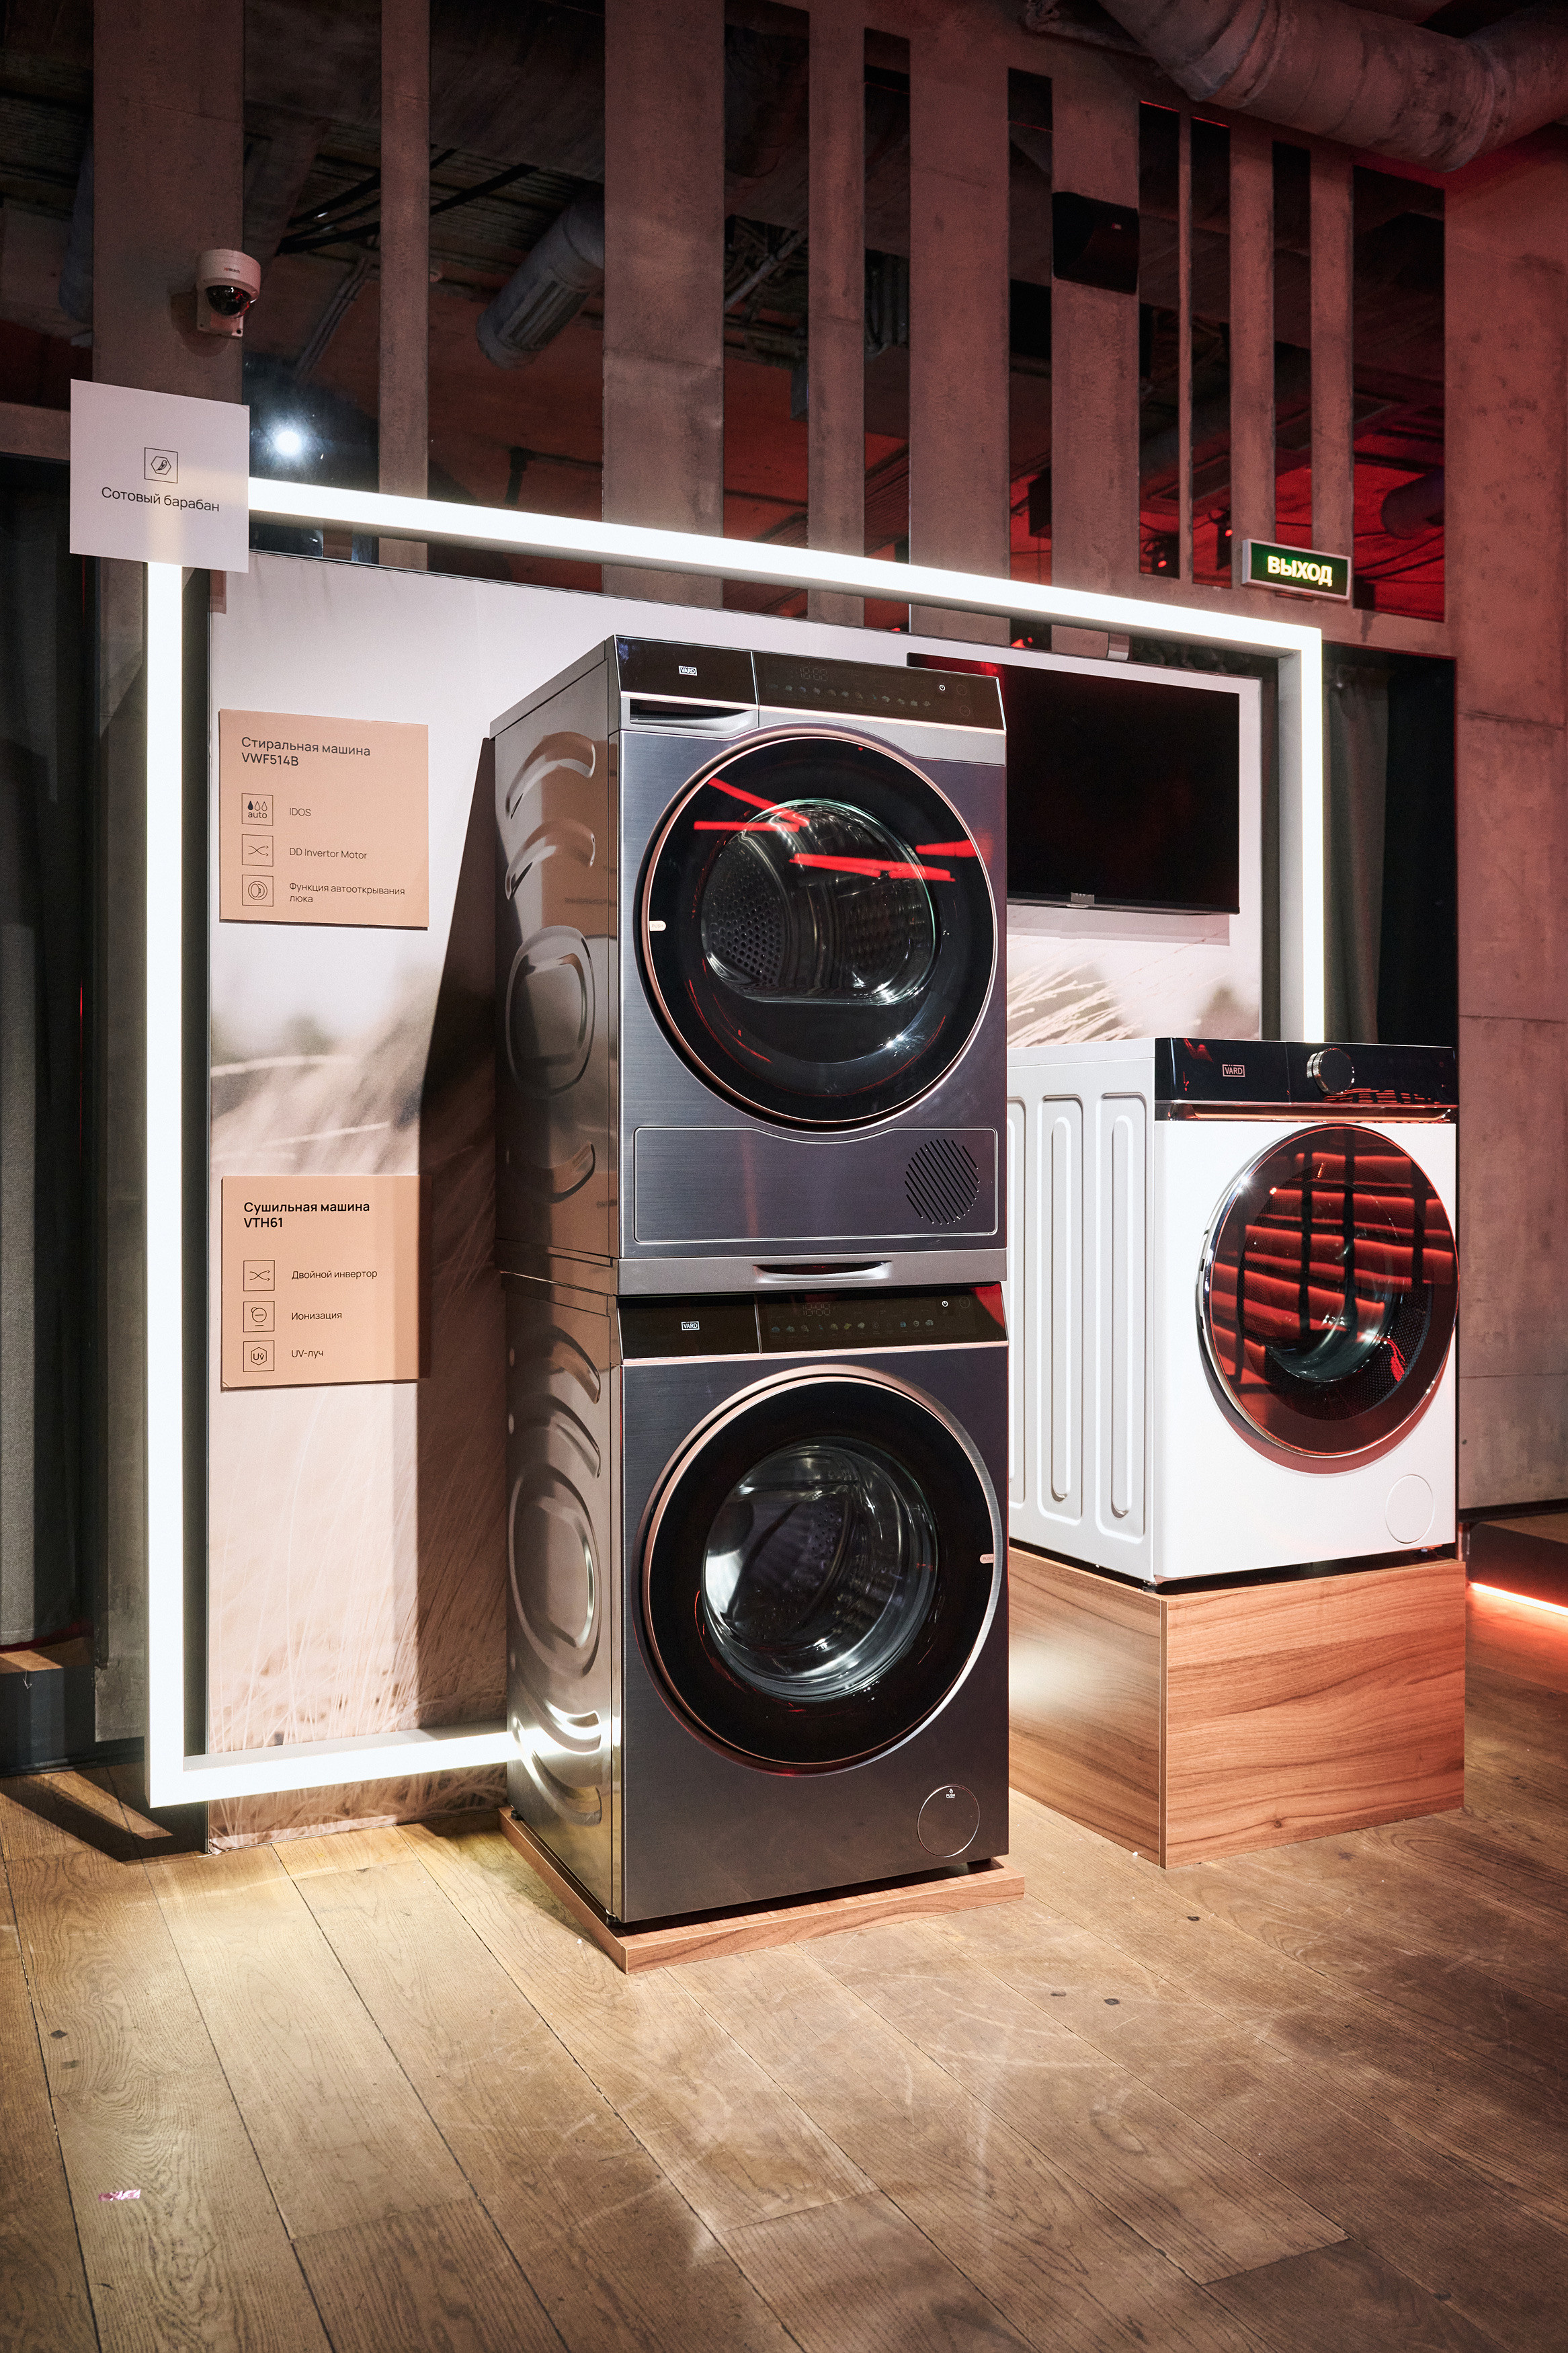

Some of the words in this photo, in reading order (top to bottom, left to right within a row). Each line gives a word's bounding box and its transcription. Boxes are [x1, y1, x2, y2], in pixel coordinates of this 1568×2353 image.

[101, 487, 161, 504] Сотовый
[163, 495, 219, 512] барабан
[1268, 555, 1333, 587] ВЫХОД
[241, 736, 319, 752] Стиральная
[322, 744, 370, 756] машина
[241, 752, 299, 766] VWF514B
[247, 810, 268, 819] auto
[289, 807, 311, 817] IDOS
[289, 847, 302, 856] DD
[304, 848, 339, 858] Invertor
[341, 850, 368, 859] Motor
[289, 882, 329, 893] Функция
[331, 885, 405, 896] автооткрывания
[289, 895, 313, 903] люка
[243, 1201, 317, 1215] Сушильная
[321, 1203, 370, 1212] машина
[243, 1217, 283, 1228] VTH61
[291, 1270, 332, 1280] Двойной
[334, 1270, 378, 1280] инвертор
[291, 1312, 342, 1321] Ионизация
[291, 1349, 324, 1359] UV-луч
